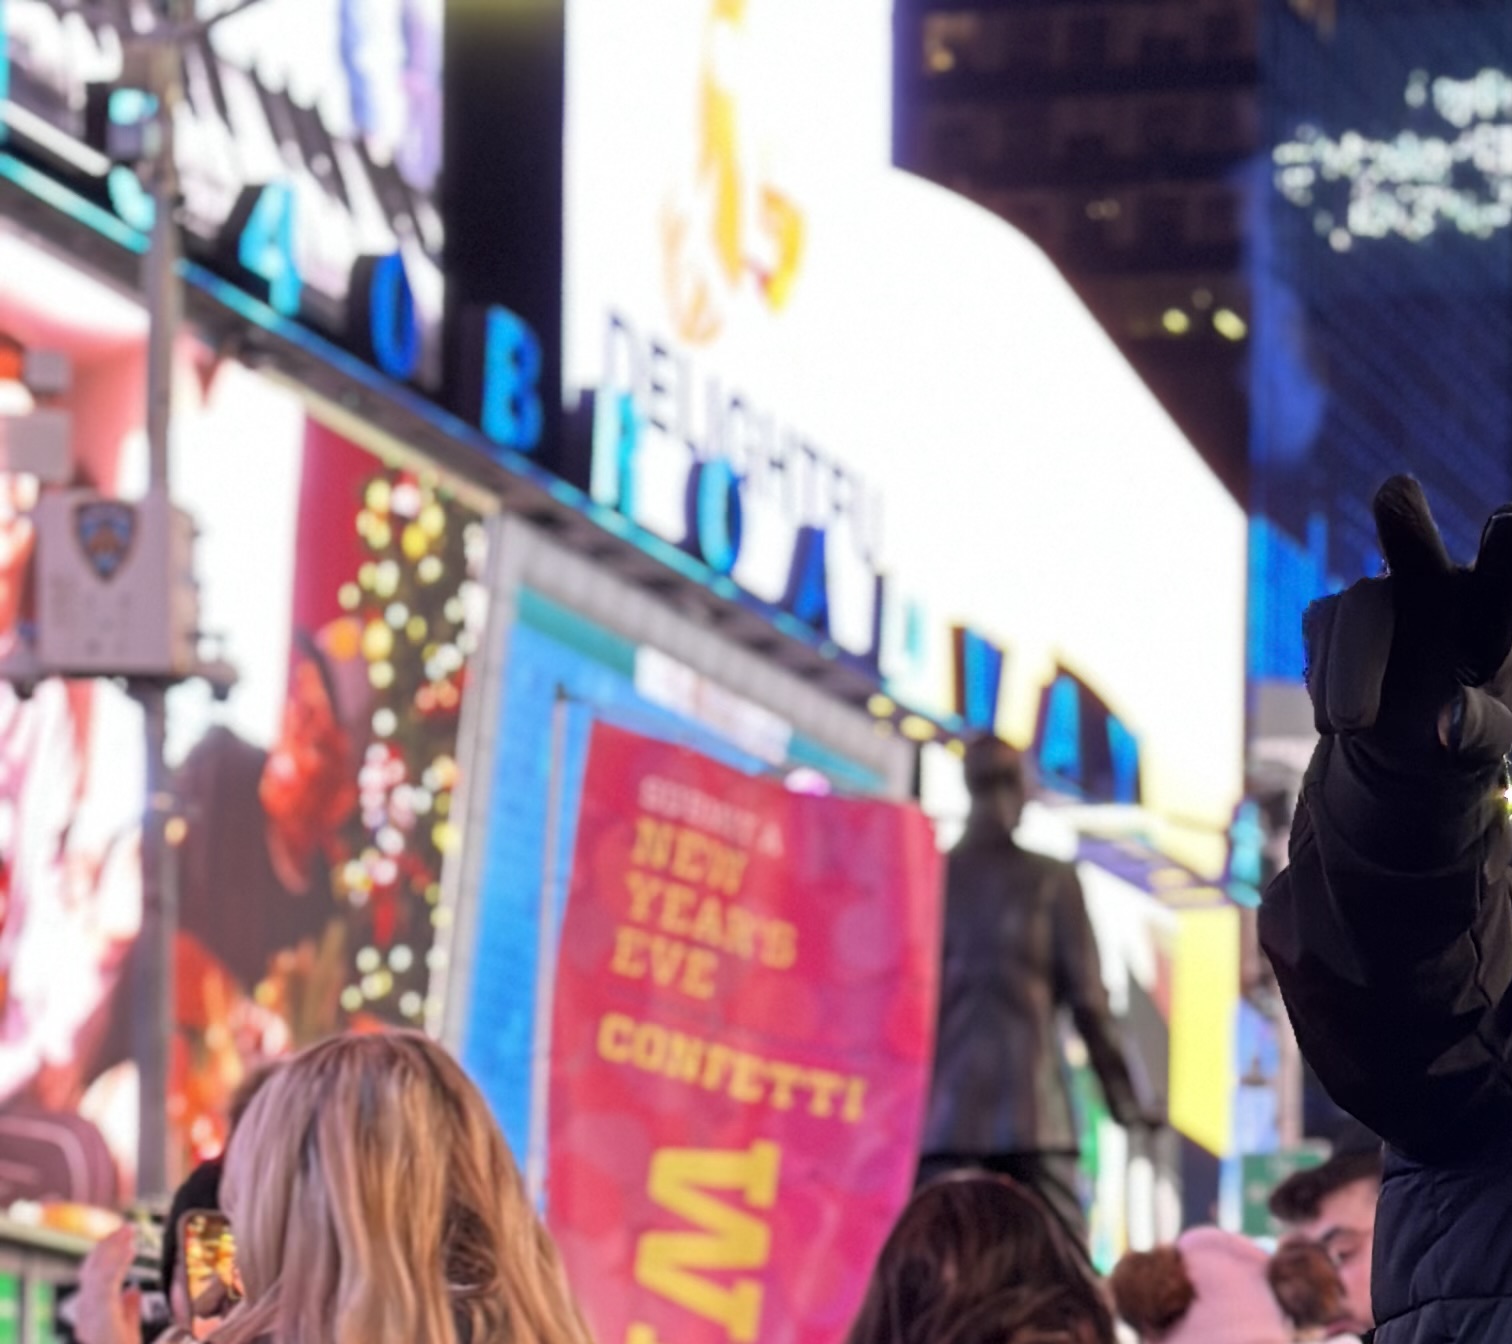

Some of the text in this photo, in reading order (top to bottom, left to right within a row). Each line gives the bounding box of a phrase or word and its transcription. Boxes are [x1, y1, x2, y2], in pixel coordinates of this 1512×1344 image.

[631, 814, 748, 897] NEW
[610, 923, 719, 1000] EVE
[598, 1010, 867, 1123] CONFETTI
